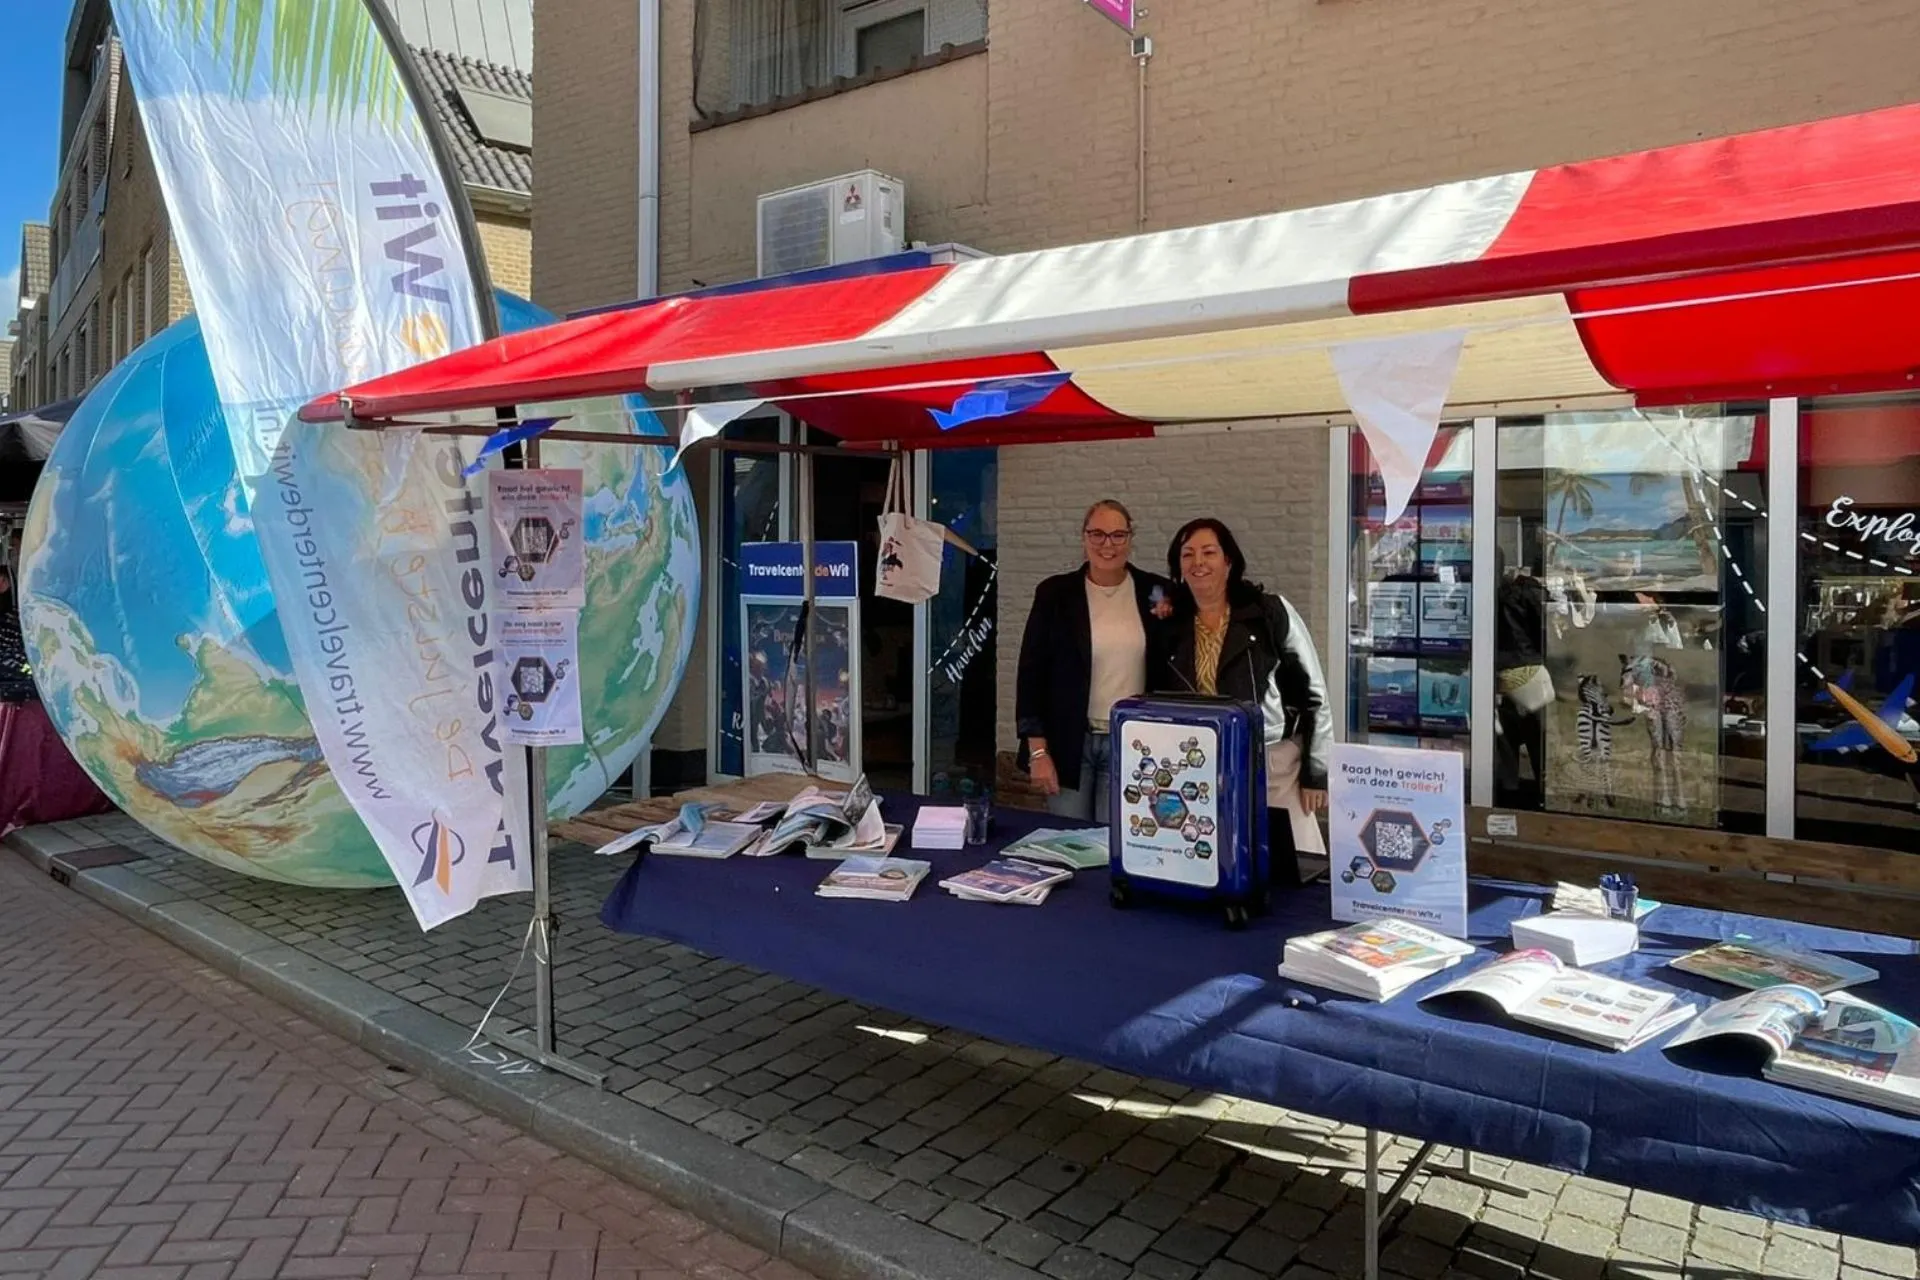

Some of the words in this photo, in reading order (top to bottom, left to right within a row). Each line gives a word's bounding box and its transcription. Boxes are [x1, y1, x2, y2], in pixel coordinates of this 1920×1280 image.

[1341, 763, 1371, 775] Raad
[1375, 767, 1393, 776] het
[1347, 776, 1367, 785] win
[1369, 777, 1398, 789] deze
